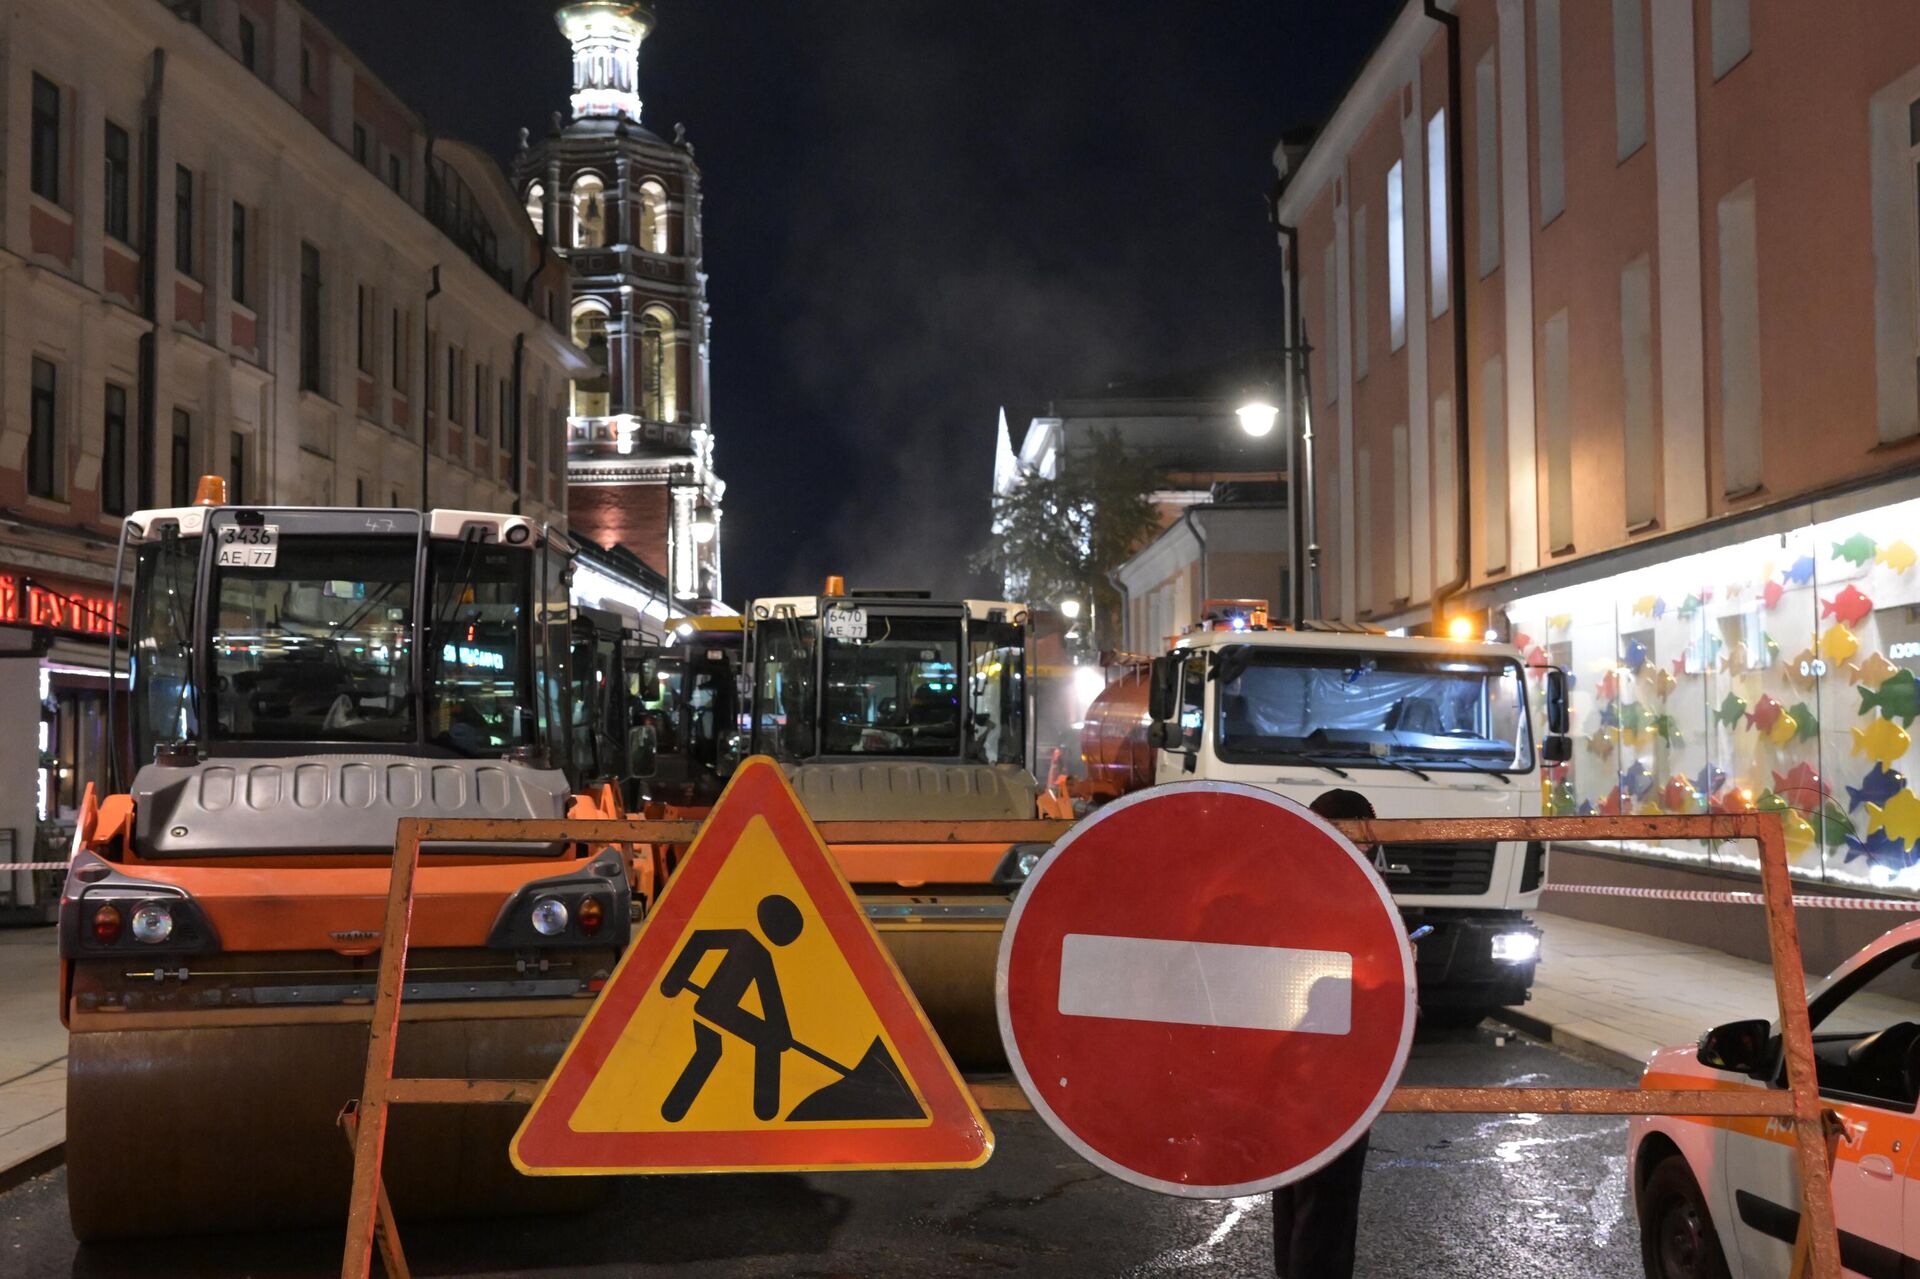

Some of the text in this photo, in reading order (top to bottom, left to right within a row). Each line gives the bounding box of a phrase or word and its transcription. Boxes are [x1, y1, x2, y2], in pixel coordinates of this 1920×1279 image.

[365, 516, 397, 532] 47
[224, 527, 271, 545] 3436
[253, 551, 272, 565] 77
[830, 610, 862, 623] 6470
[851, 626, 863, 636] 77
